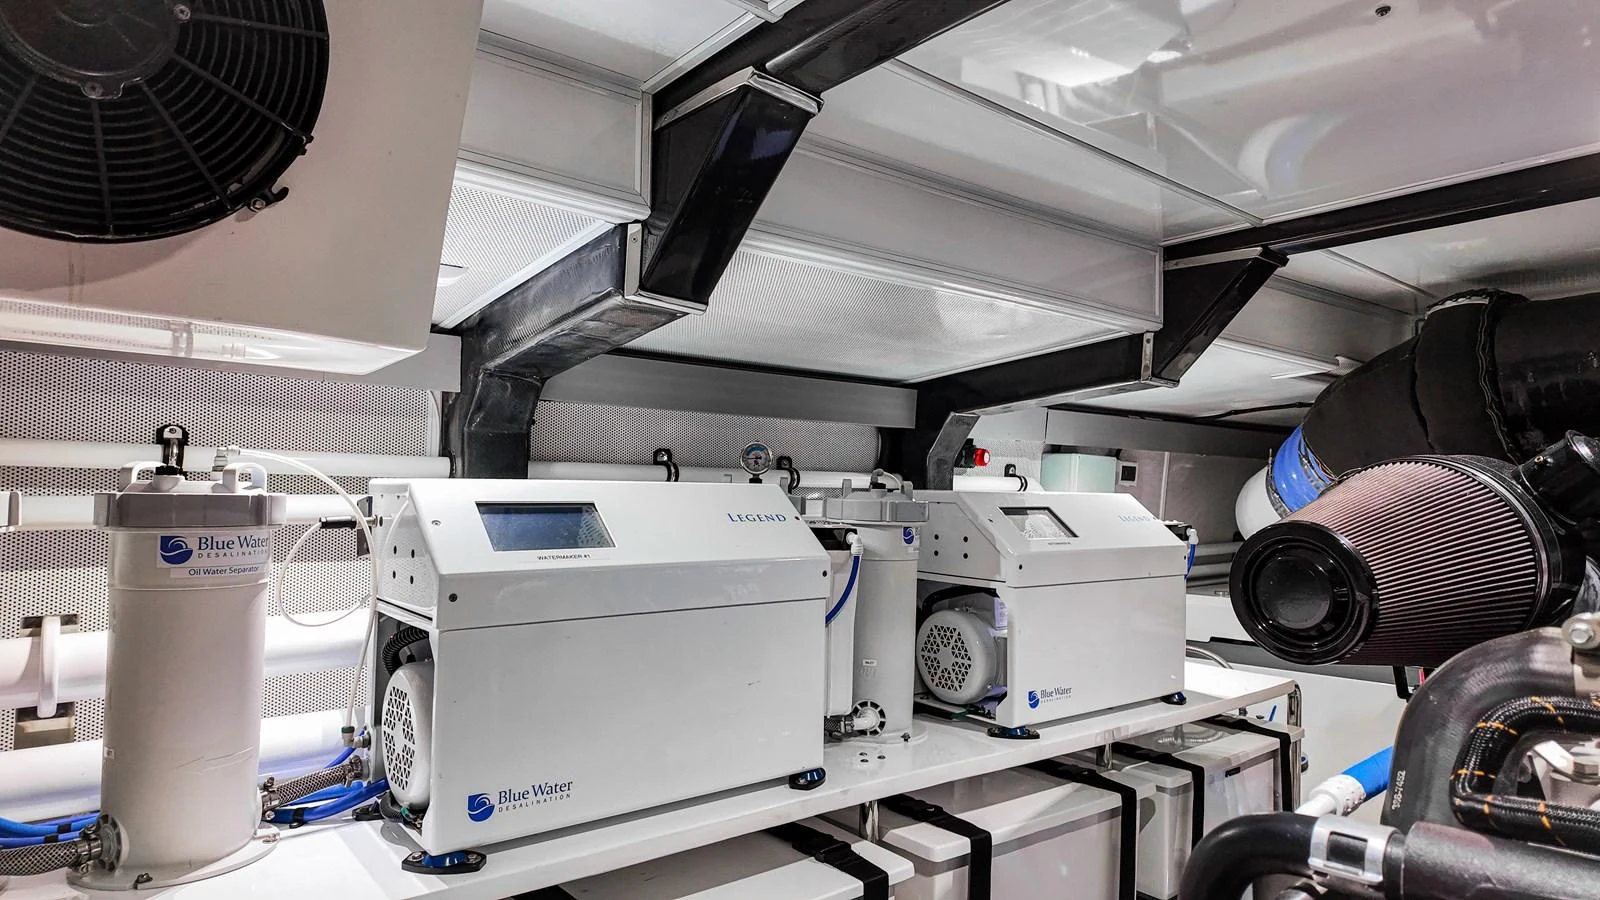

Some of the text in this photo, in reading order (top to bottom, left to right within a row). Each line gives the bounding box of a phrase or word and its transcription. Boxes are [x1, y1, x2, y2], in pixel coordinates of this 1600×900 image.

[727, 513, 787, 522] LEGEND
[198, 535, 269, 550] Blue Water
[198, 550, 267, 559] DESALINATION
[188, 568, 200, 576] Oil
[229, 566, 259, 575] Separator
[1041, 687, 1072, 699] Blue Water
[498, 780, 573, 805] Blue Water
[498, 794, 571, 812] DESALINATION
